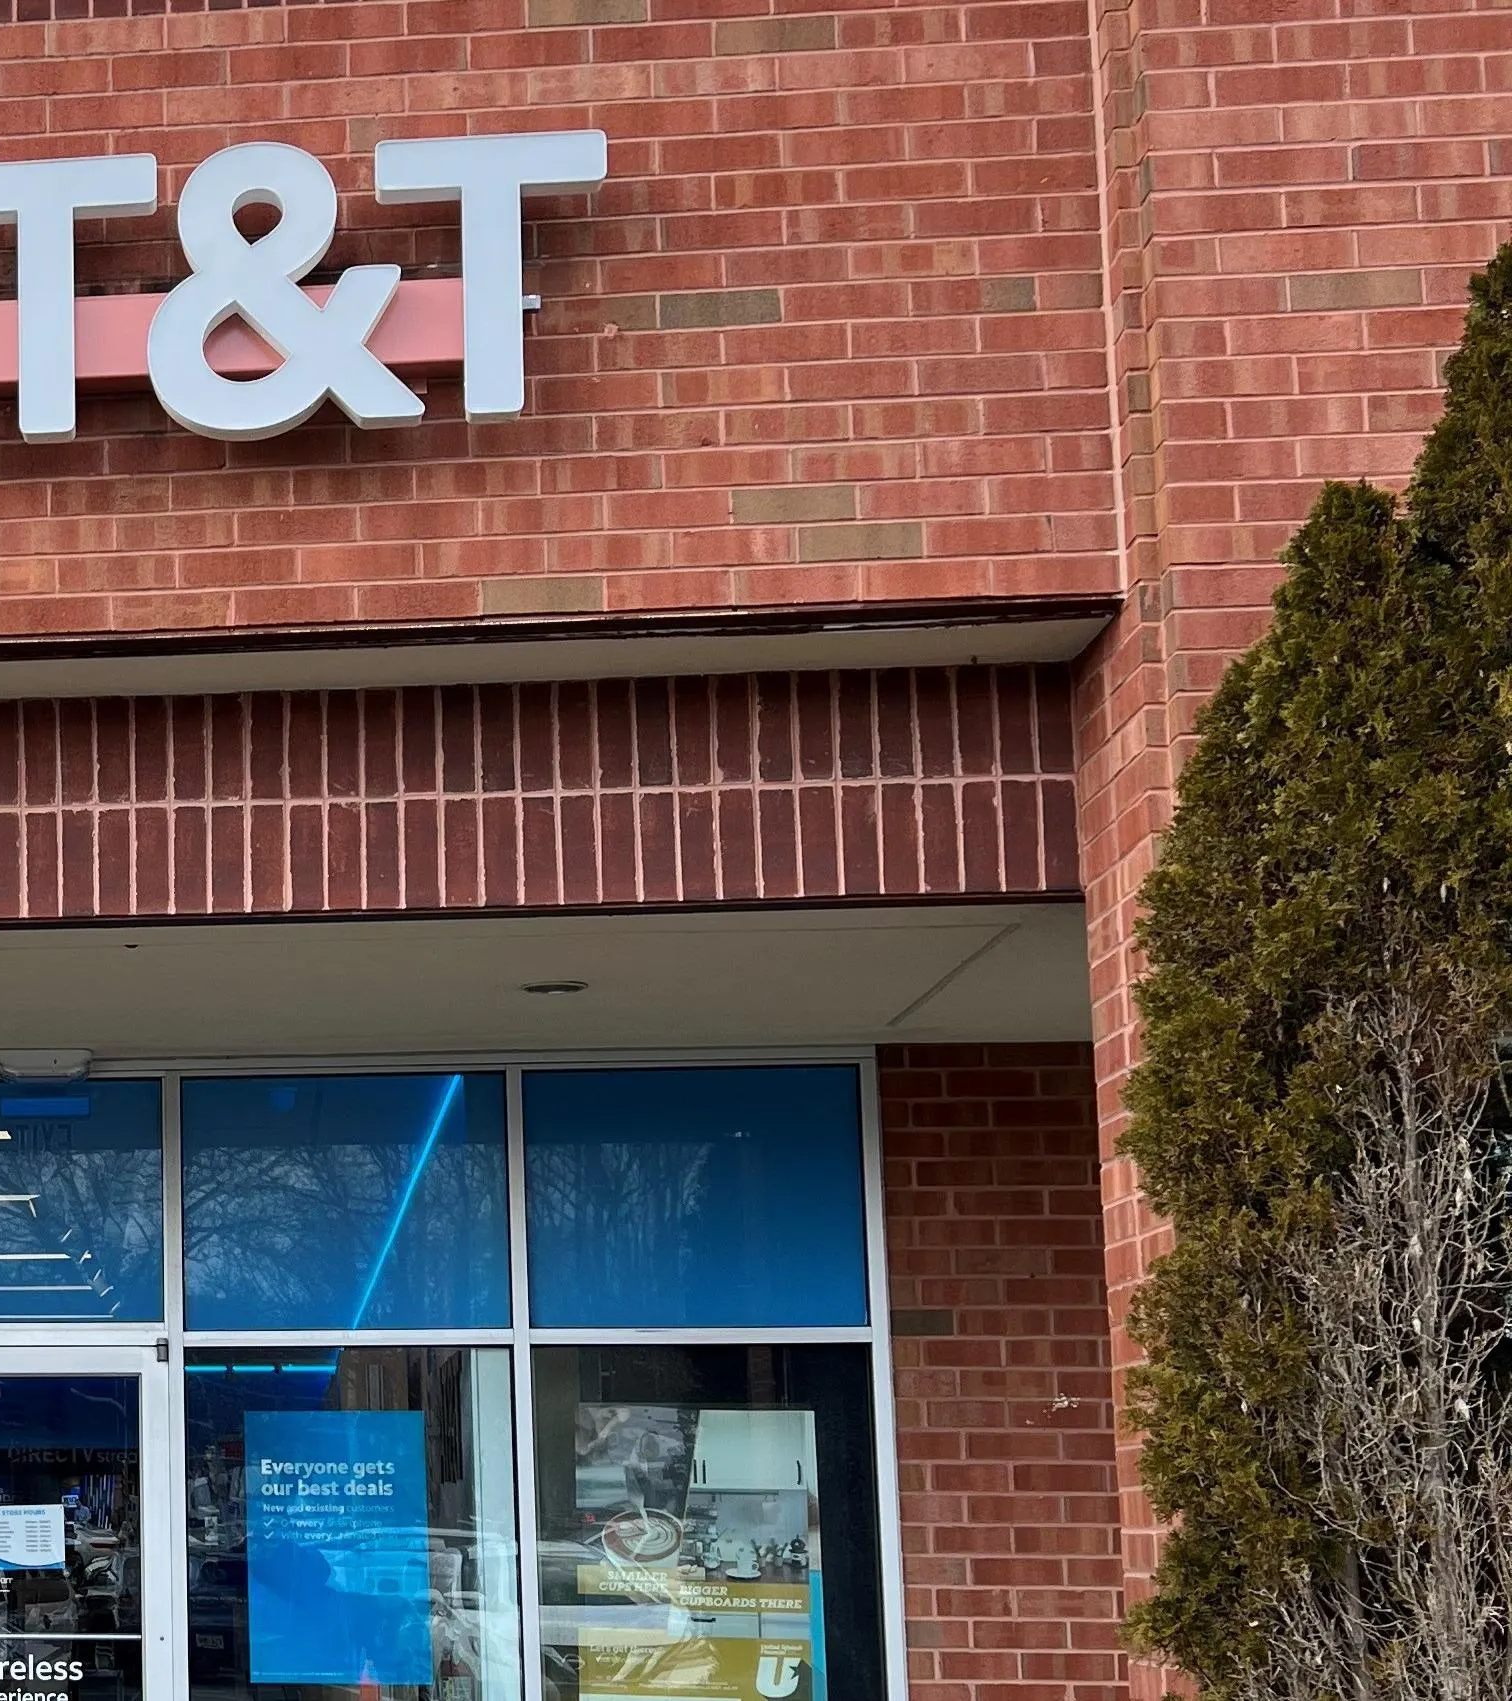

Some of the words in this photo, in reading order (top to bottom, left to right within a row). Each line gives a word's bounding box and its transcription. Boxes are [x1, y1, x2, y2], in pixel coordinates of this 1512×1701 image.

[261, 1459, 348, 1479] Everyone
[353, 1460, 395, 1479] gets
[261, 1483, 293, 1496] our
[297, 1479, 340, 1496] best
[344, 1479, 393, 1496] deals
[263, 1504, 284, 1512] New
[305, 1504, 345, 1515] existing
[679, 1584, 728, 1596] BIGGER
[680, 1596, 756, 1608] CUPBOARDS
[759, 1598, 803, 1609] THERE
